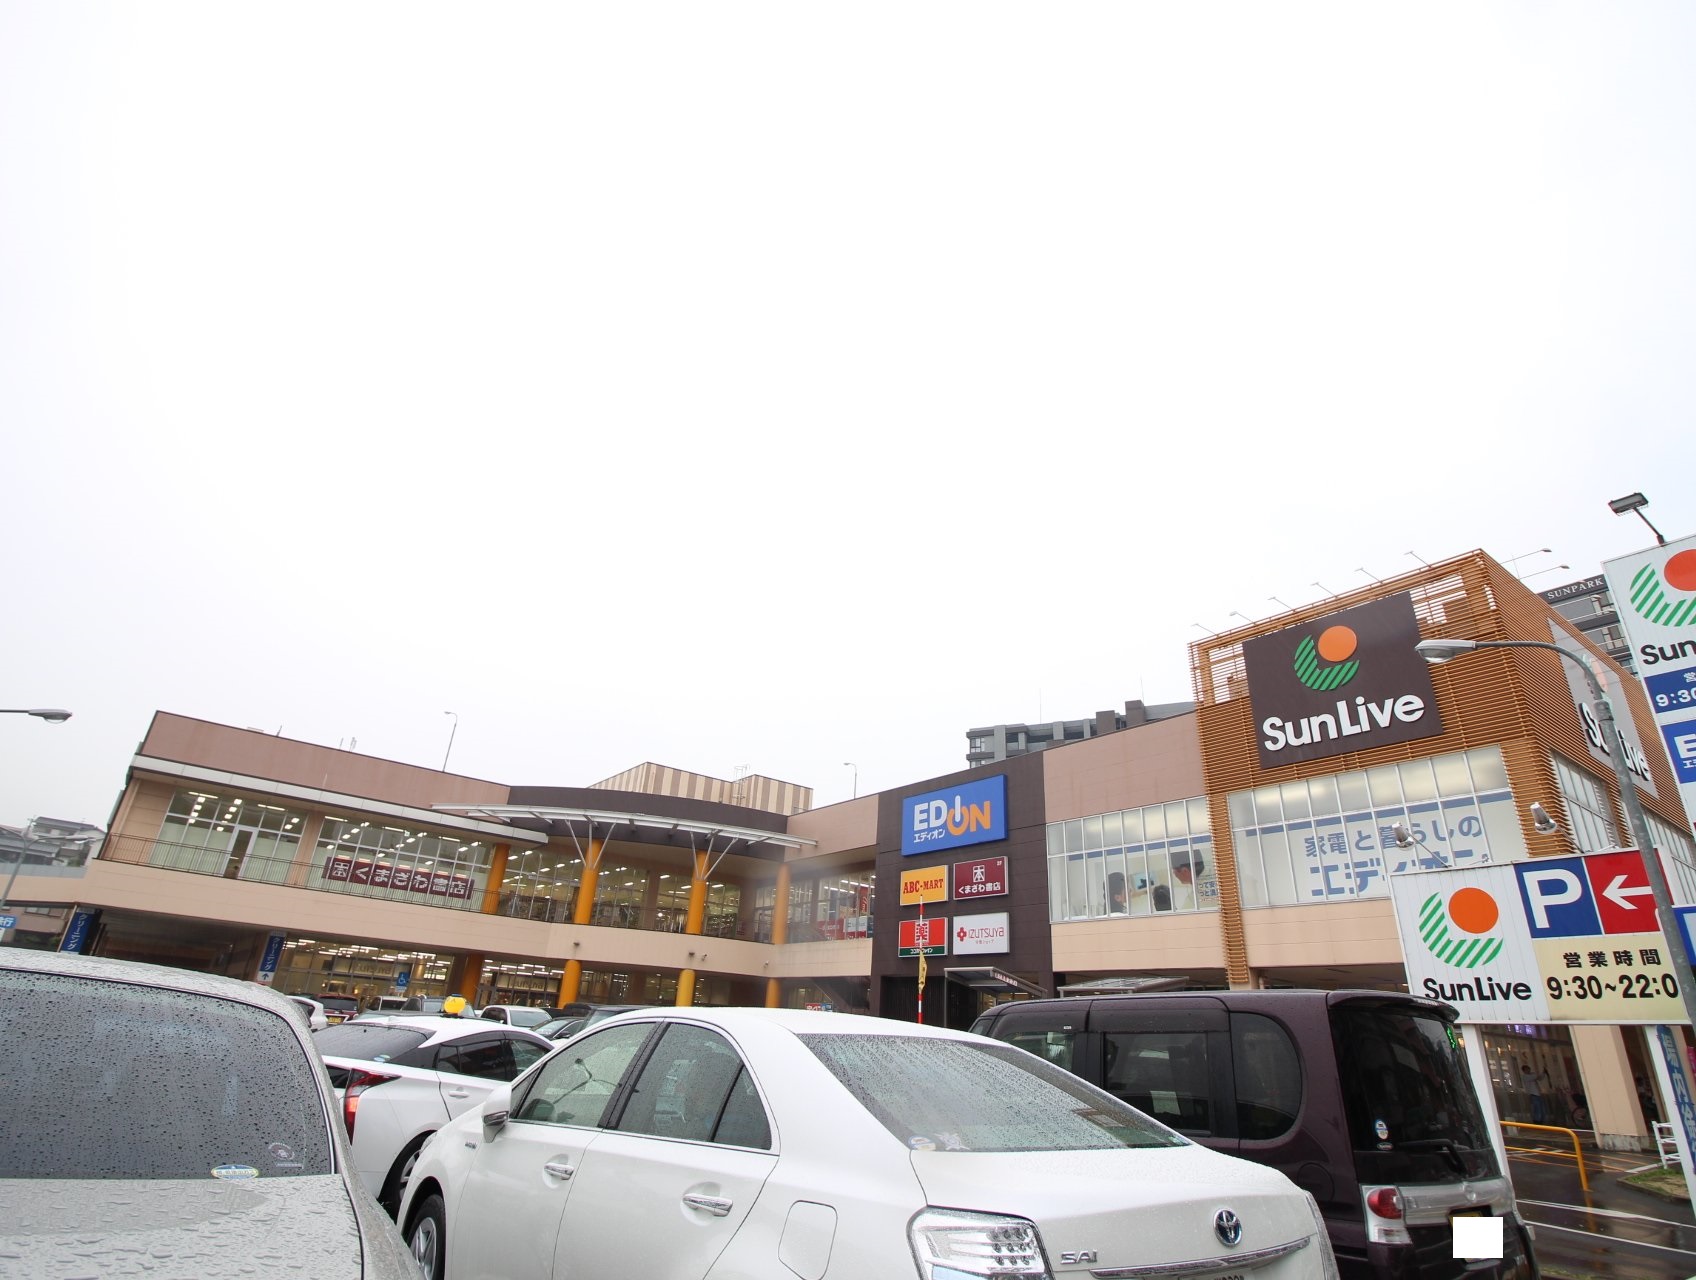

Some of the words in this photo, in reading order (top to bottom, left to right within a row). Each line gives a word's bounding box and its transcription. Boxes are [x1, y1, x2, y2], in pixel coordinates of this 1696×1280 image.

[1547, 578, 1604, 600] SUNPARK
[1262, 694, 1425, 751] SunLive
[913, 795, 990, 836] EDION
[913, 828, 946, 843] エディオン
[903, 878, 944, 894] ABC-MART
[958, 882, 1001, 894] くまざわ書店
[1522, 869, 1582, 929] P
[1563, 949, 1662, 969] 営業時間
[1423, 976, 1532, 1001] SunLive
[1547, 973, 1680, 1000] 9:30~22:0
[1061, 1250, 1098, 1264] SAI
